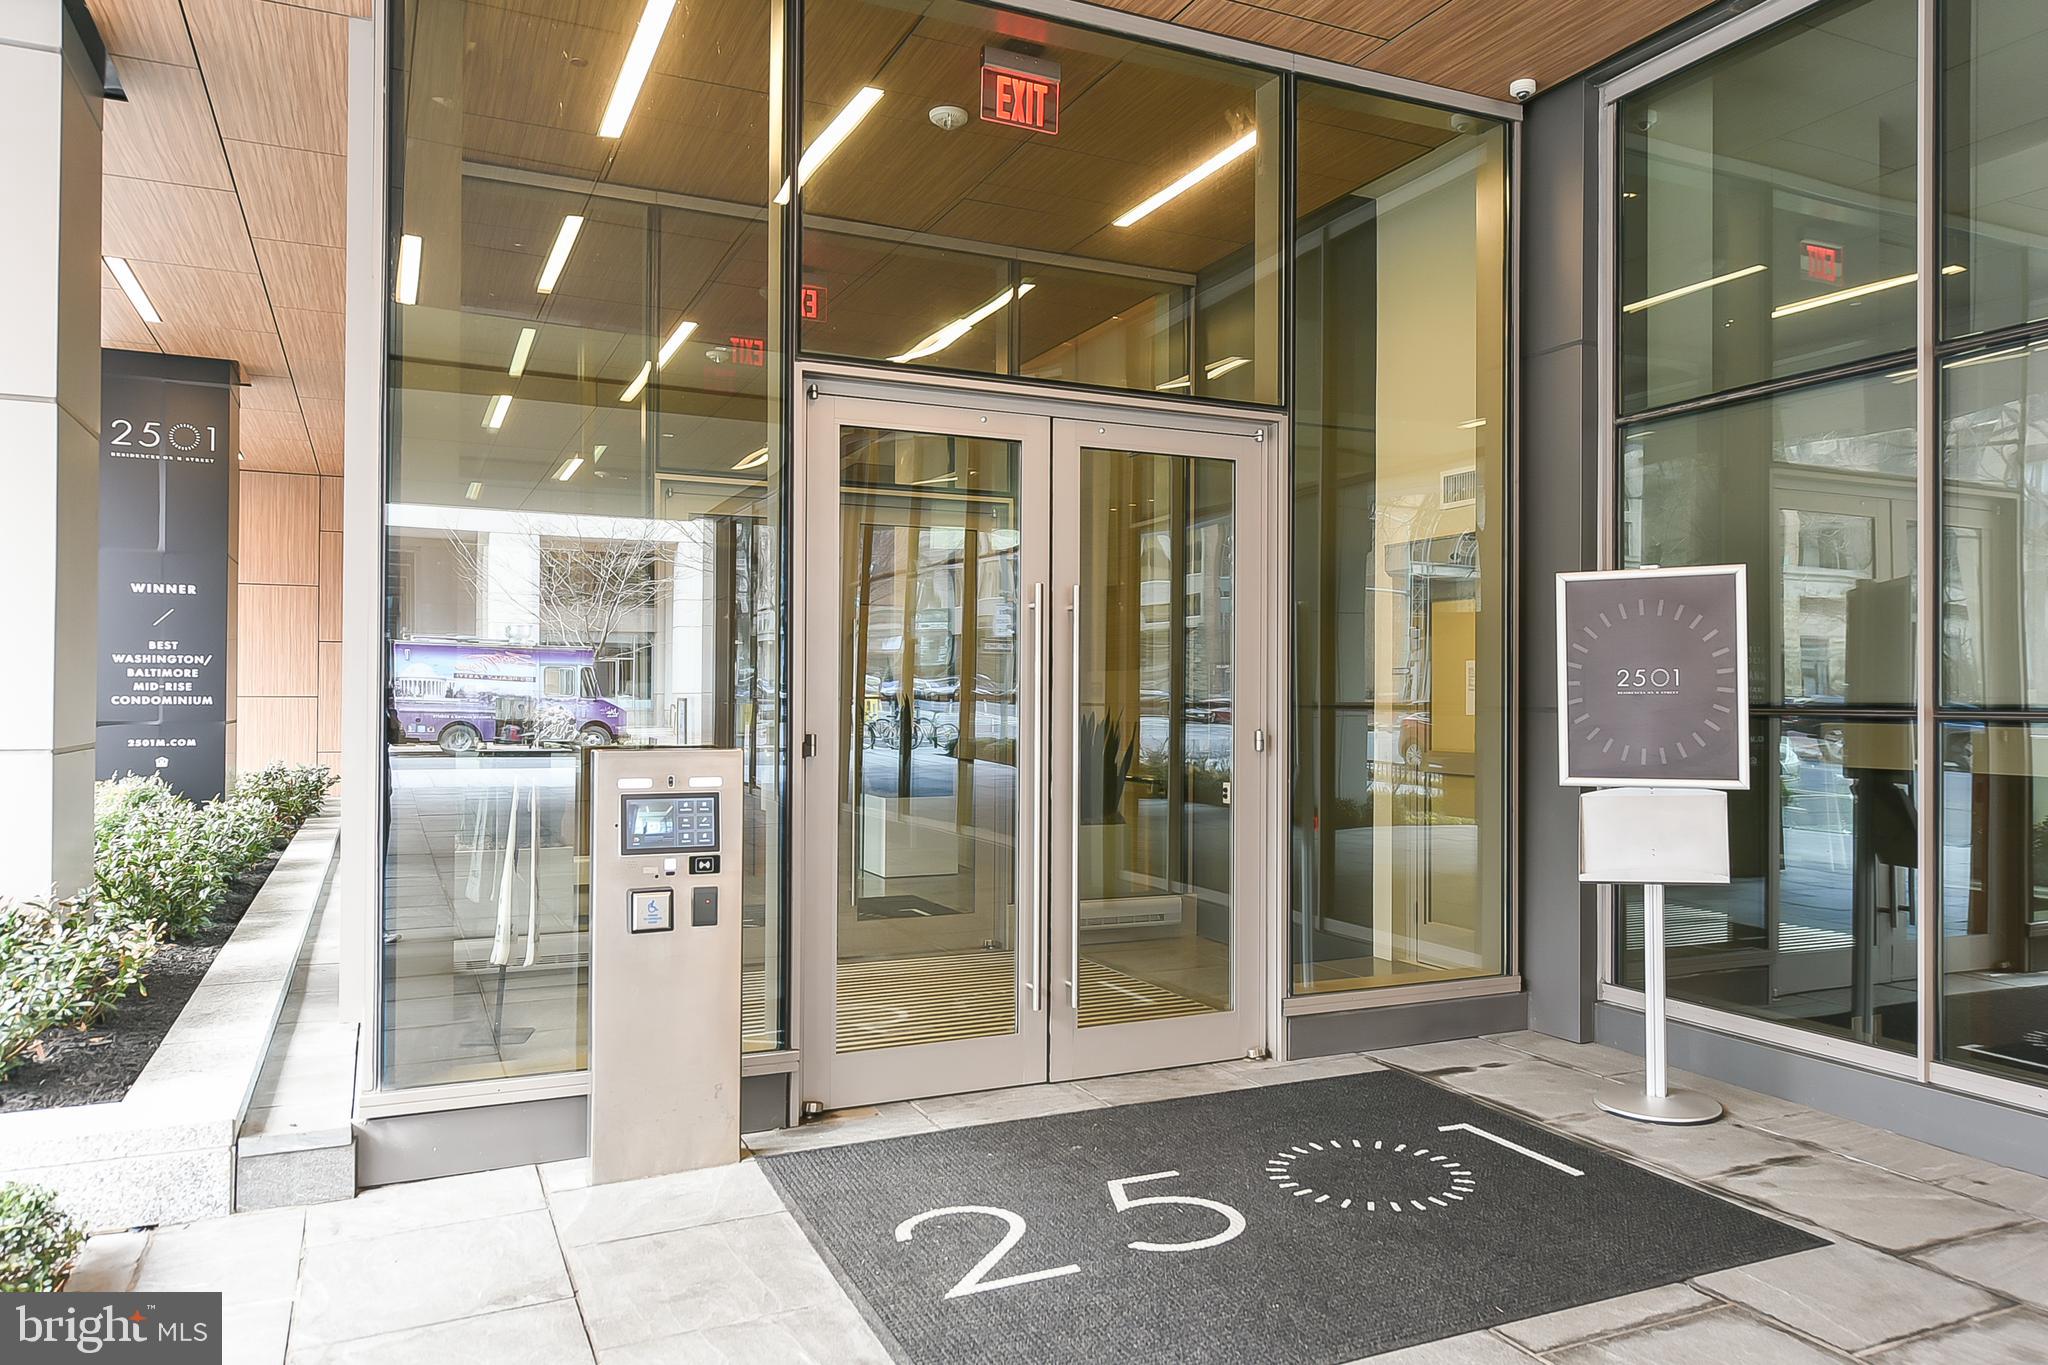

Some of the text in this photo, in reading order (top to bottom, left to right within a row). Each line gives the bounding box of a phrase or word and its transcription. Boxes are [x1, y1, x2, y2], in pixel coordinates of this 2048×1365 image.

[995, 74, 1048, 128] EXIT
[110, 419, 217, 452] 2501
[130, 582, 197, 595] WINNER
[148, 640, 178, 650] BEST
[112, 653, 213, 666] WASHINGTON/
[126, 668, 199, 678] BALTIMORE
[1617, 668, 1680, 687] 2501
[133, 682, 193, 691] MID-RISE
[110, 695, 214, 705] CONDOMINIUM
[127, 738, 197, 747] 2501M.COM
